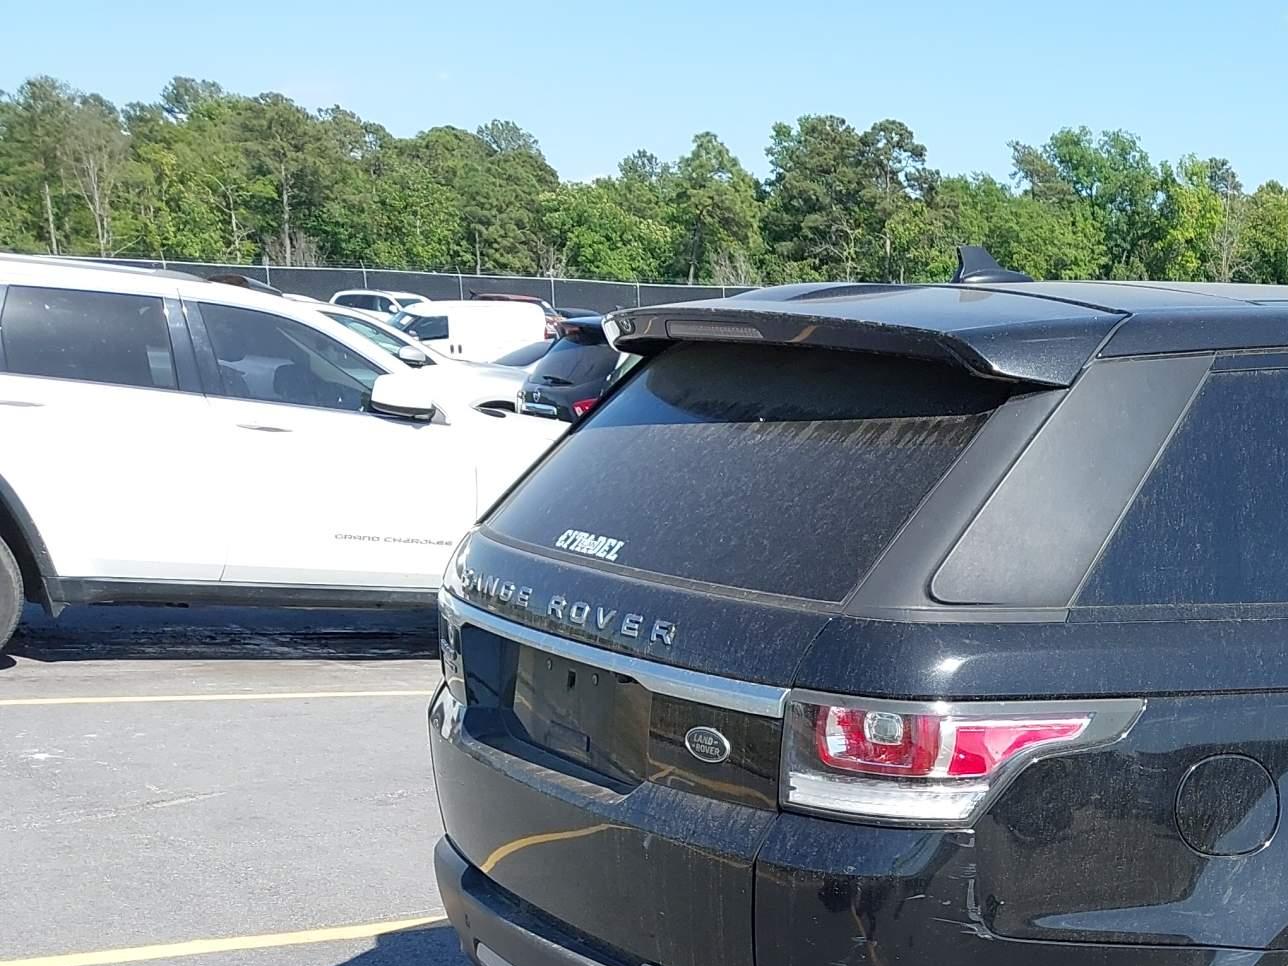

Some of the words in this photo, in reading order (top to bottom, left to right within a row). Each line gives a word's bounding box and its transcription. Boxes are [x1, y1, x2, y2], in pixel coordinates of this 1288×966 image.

[334, 533, 380, 542] GRAND
[384, 536, 453, 546] CHEROKEE
[555, 529, 625, 562] CITADEL
[547, 594, 677, 645] ROVER
